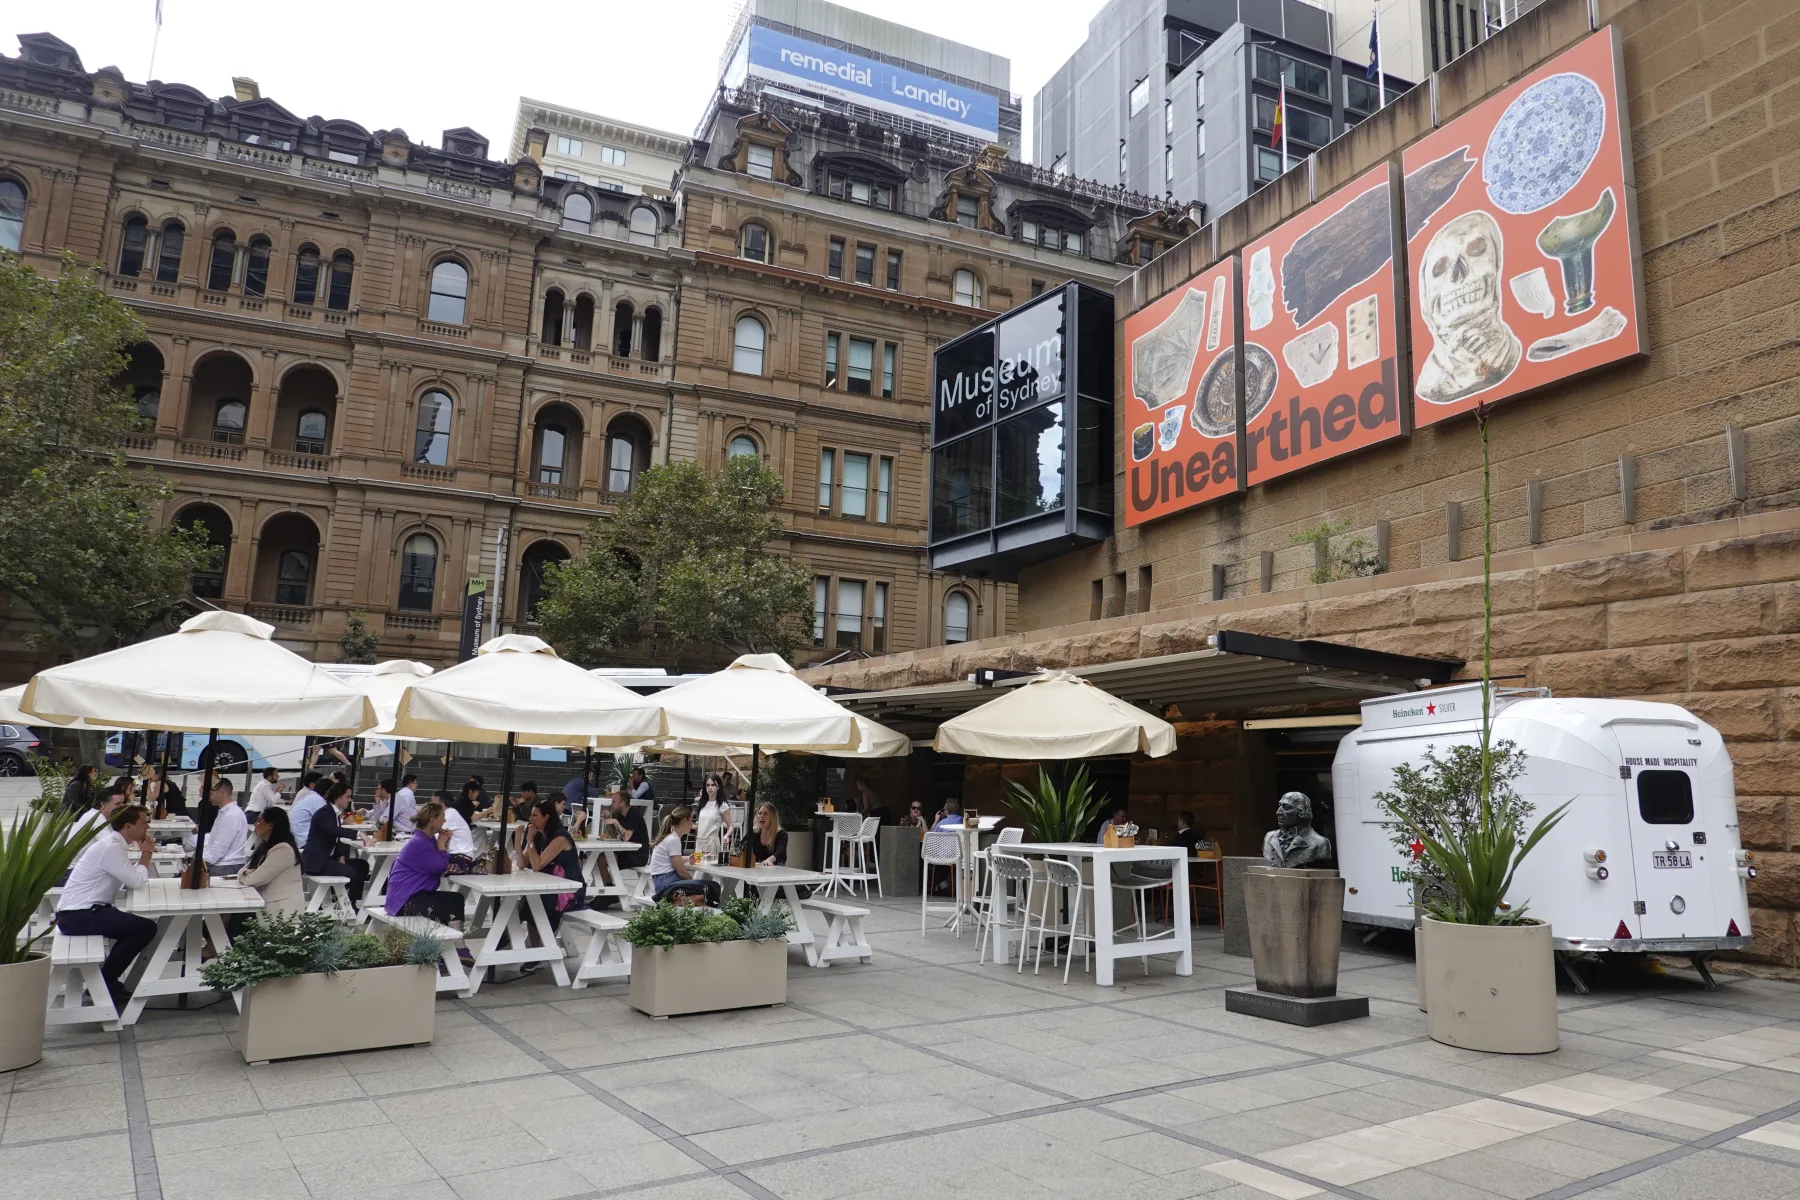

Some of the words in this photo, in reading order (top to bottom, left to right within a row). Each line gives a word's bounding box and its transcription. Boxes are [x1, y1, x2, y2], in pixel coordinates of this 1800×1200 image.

[781, 48, 873, 88] remedial
[891, 76, 972, 118] Landlay
[940, 335, 1061, 412] Museum
[975, 393, 993, 419] of
[999, 371, 1061, 411] Sydney
[1131, 357, 1397, 513] Unearthed
[474, 596, 485, 620] Sydney
[474, 620, 481, 628] of
[472, 628, 481, 656] Museum
[1392, 707, 1424, 719] Heineken
[1438, 702, 1456, 713] SILVER
[1625, 757, 1643, 766] HOUSE
[1645, 757, 1660, 766] MADE
[1663, 758, 1697, 767] HOSPITALITY
